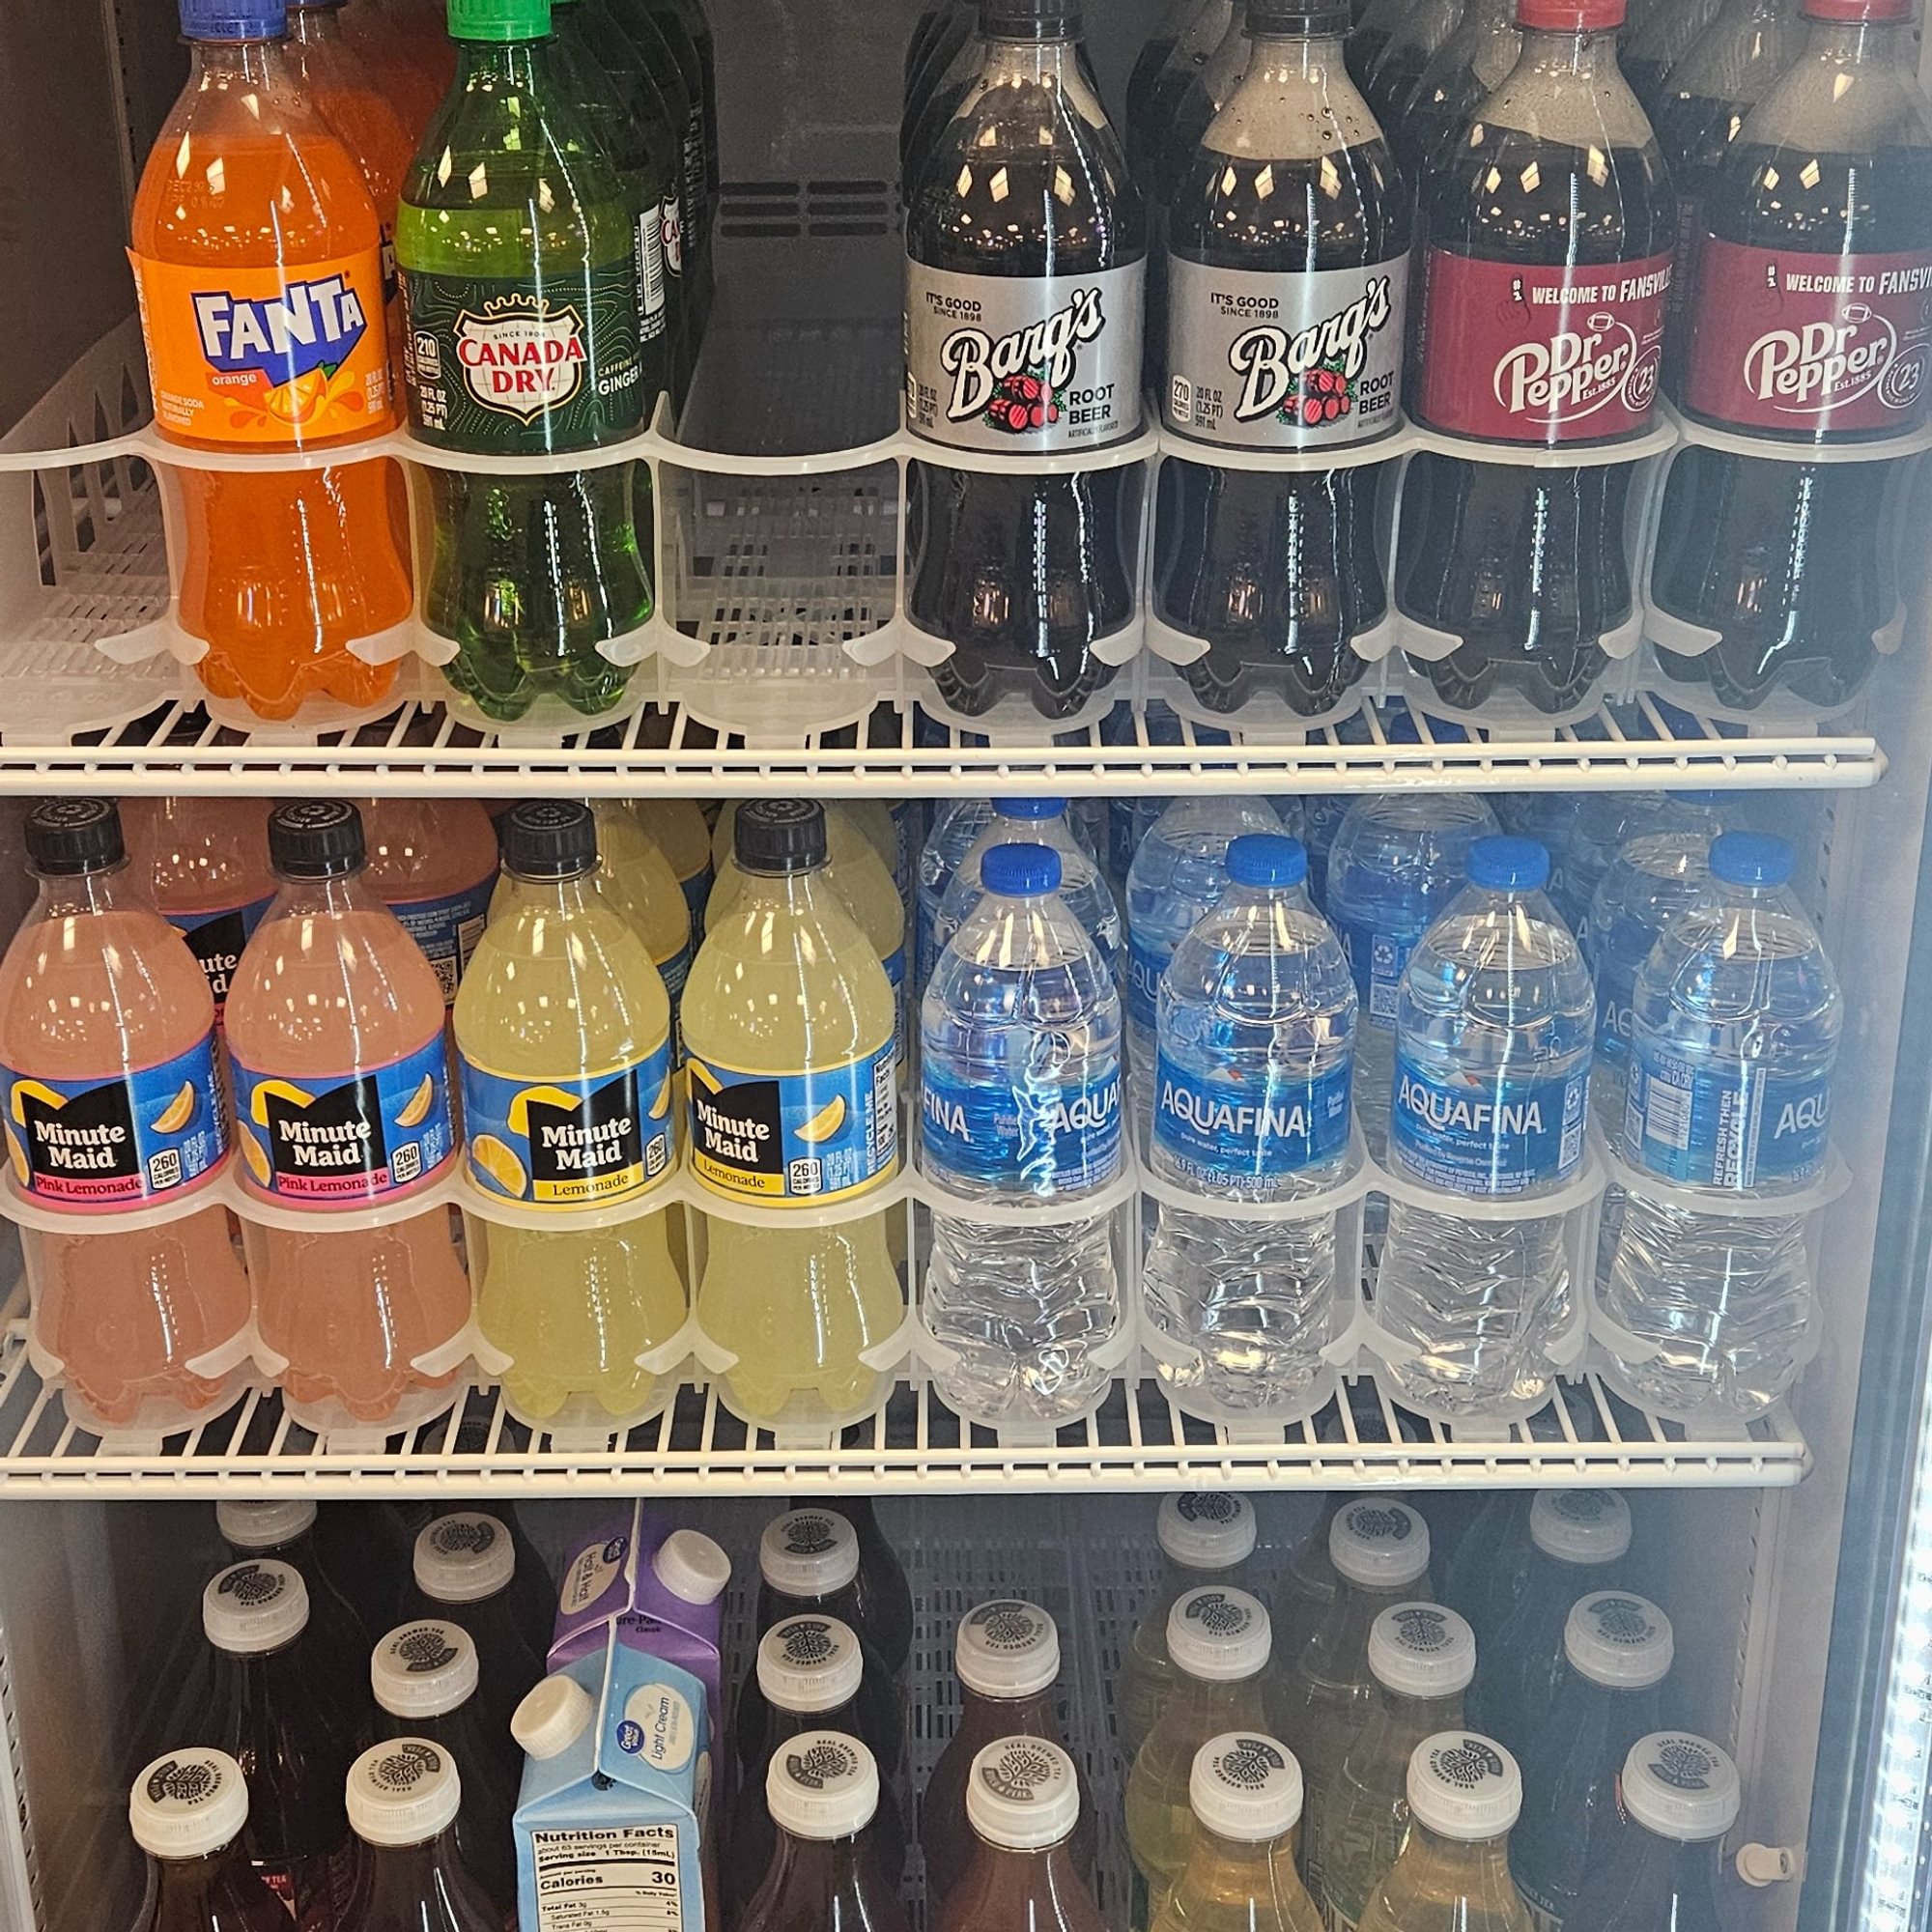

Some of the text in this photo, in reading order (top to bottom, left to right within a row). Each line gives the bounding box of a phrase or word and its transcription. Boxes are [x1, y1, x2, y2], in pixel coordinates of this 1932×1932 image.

[1532, 286, 1598, 304] WELCOME
[1601, 284, 1617, 301] TO
[1786, 273, 1854, 293] WELCOME
[1858, 276, 1875, 294] TO
[945, 298, 981, 312] GOOD
[1210, 293, 1279, 309] IT'S GOOD
[192, 275, 365, 361] FANTA
[933, 306, 981, 322] SINCE 1898
[1220, 306, 1279, 320] SINCE 1898
[494, 330, 521, 340] SINCE
[1801, 322, 1859, 365] Dr
[417, 337, 437, 357] 210
[458, 338, 585, 367] CANADA
[940, 287, 1106, 423] Barq's
[1228, 275, 1391, 423] Barq's
[1548, 331, 1603, 376] Dr
[1745, 329, 1889, 403] Pepper
[1898, 362, 1921, 392] 23
[212, 372, 258, 386] orange
[1360, 371, 1395, 396] ROOT
[1494, 342, 1631, 414] Pepper
[1637, 364, 1655, 396] 23
[1069, 384, 1115, 407] ROOT
[1174, 380, 1189, 402] 270
[1359, 392, 1391, 414] BEER
[1069, 405, 1112, 425] BEER
[199, 952, 240, 974] ute
[1052, 1070, 1122, 1134] AQUA
[1160, 1080, 1308, 1138] AQUAFINA
[1398, 1074, 1544, 1136] AQUAFINA
[696, 1099, 771, 1141] Minute
[923, 1084, 970, 1145] FINA
[34, 1120, 127, 1147] Minute
[278, 1120, 372, 1144] Minute
[541, 1117, 633, 1148] Minute
[1712, 1090, 1733, 1186] REFRESH THEN
[293, 1142, 362, 1167] Maid
[555, 1140, 623, 1170] Maid
[704, 1127, 759, 1163] Maid
[1220, 1145, 1250, 1157] perfect
[1456, 1139, 1488, 1151] perfect
[1489, 1142, 1511, 1151] tste
[47, 1147, 117, 1169] Maid
[152, 1151, 178, 1173] 260
[395, 1146, 417, 1167] 260
[278, 1172, 388, 1192] Pink Lemonade
[703, 1159, 766, 1188] Lemonade
[792, 1163, 818, 1179] 260
[36, 1176, 142, 1195] Pink Lemonade
[554, 1174, 629, 1196] Lemonade
[651, 1697, 670, 1761] Light Cream
[535, 1827, 674, 1844] Nutrition Facts
[538, 1845, 560, 1855] about
[538, 1853, 575, 1862] Serving
[541, 1871, 676, 1890] Calories 30
[542, 1904, 562, 1913] Total
[551, 1912, 582, 1921] Saturated
